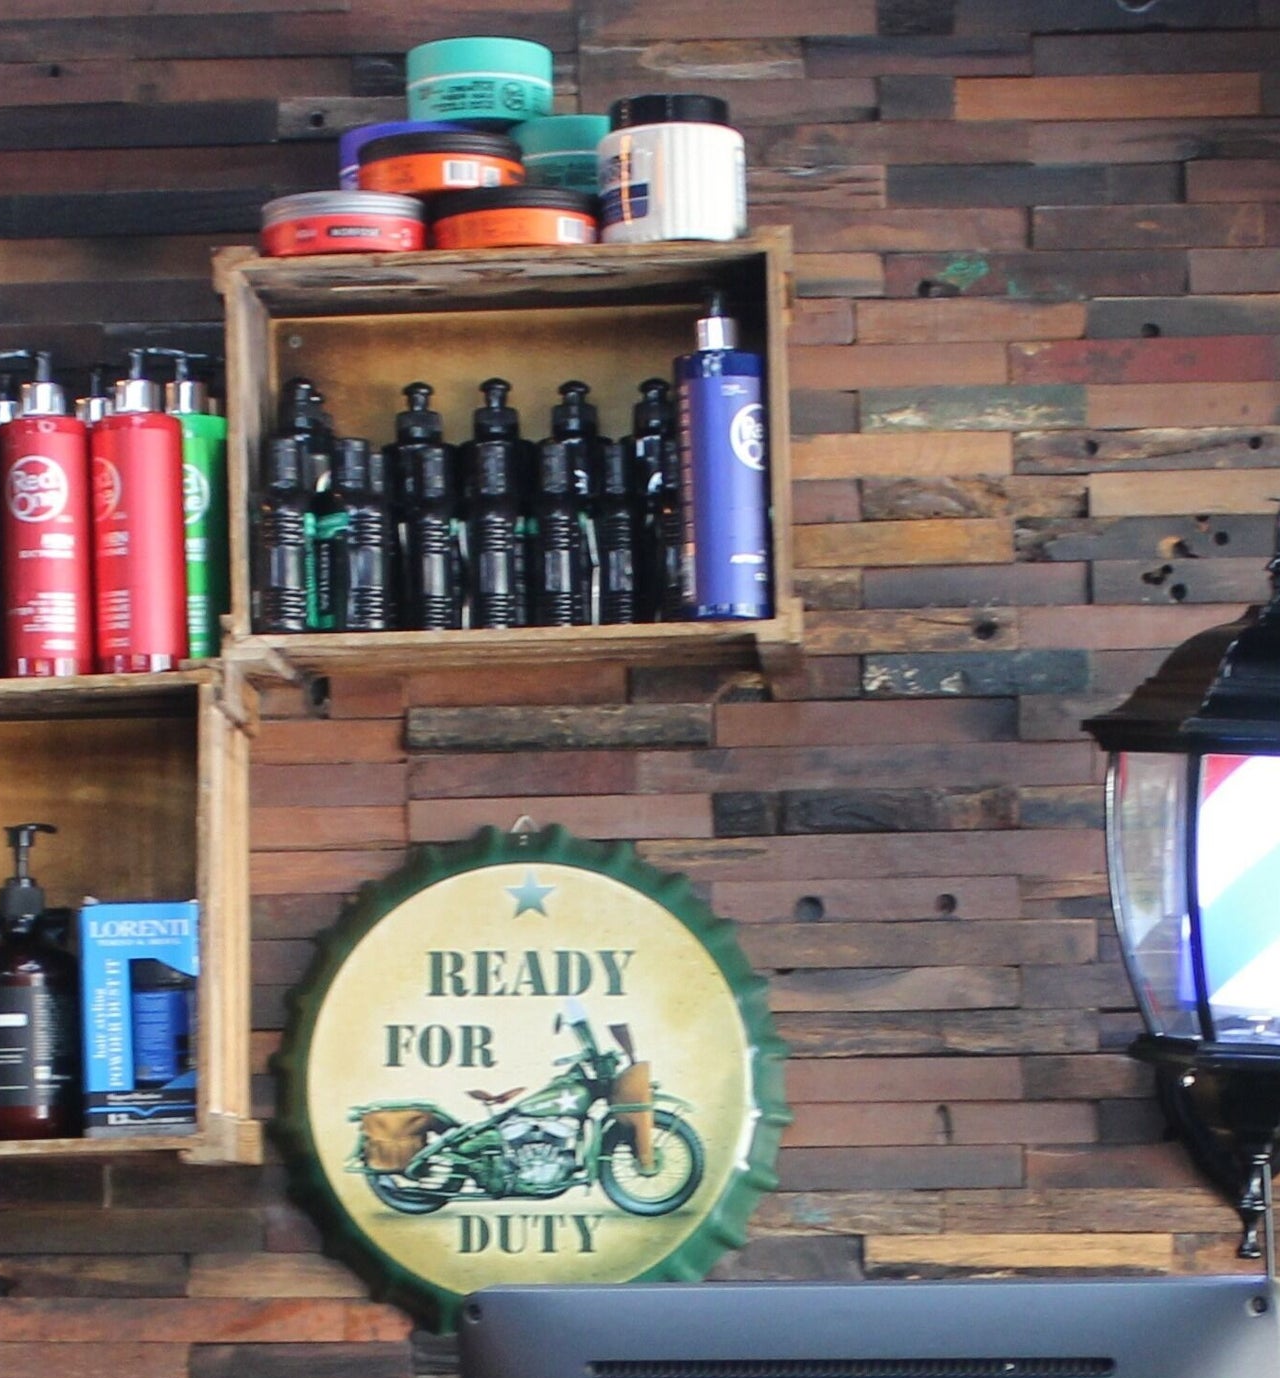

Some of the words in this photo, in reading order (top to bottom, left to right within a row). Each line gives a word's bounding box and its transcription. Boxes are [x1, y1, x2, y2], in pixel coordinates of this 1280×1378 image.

[88, 918, 190, 939] LORENTI
[426, 949, 637, 998] READY
[383, 1023, 497, 1069] FOR
[457, 1213, 604, 1255] DUTY
